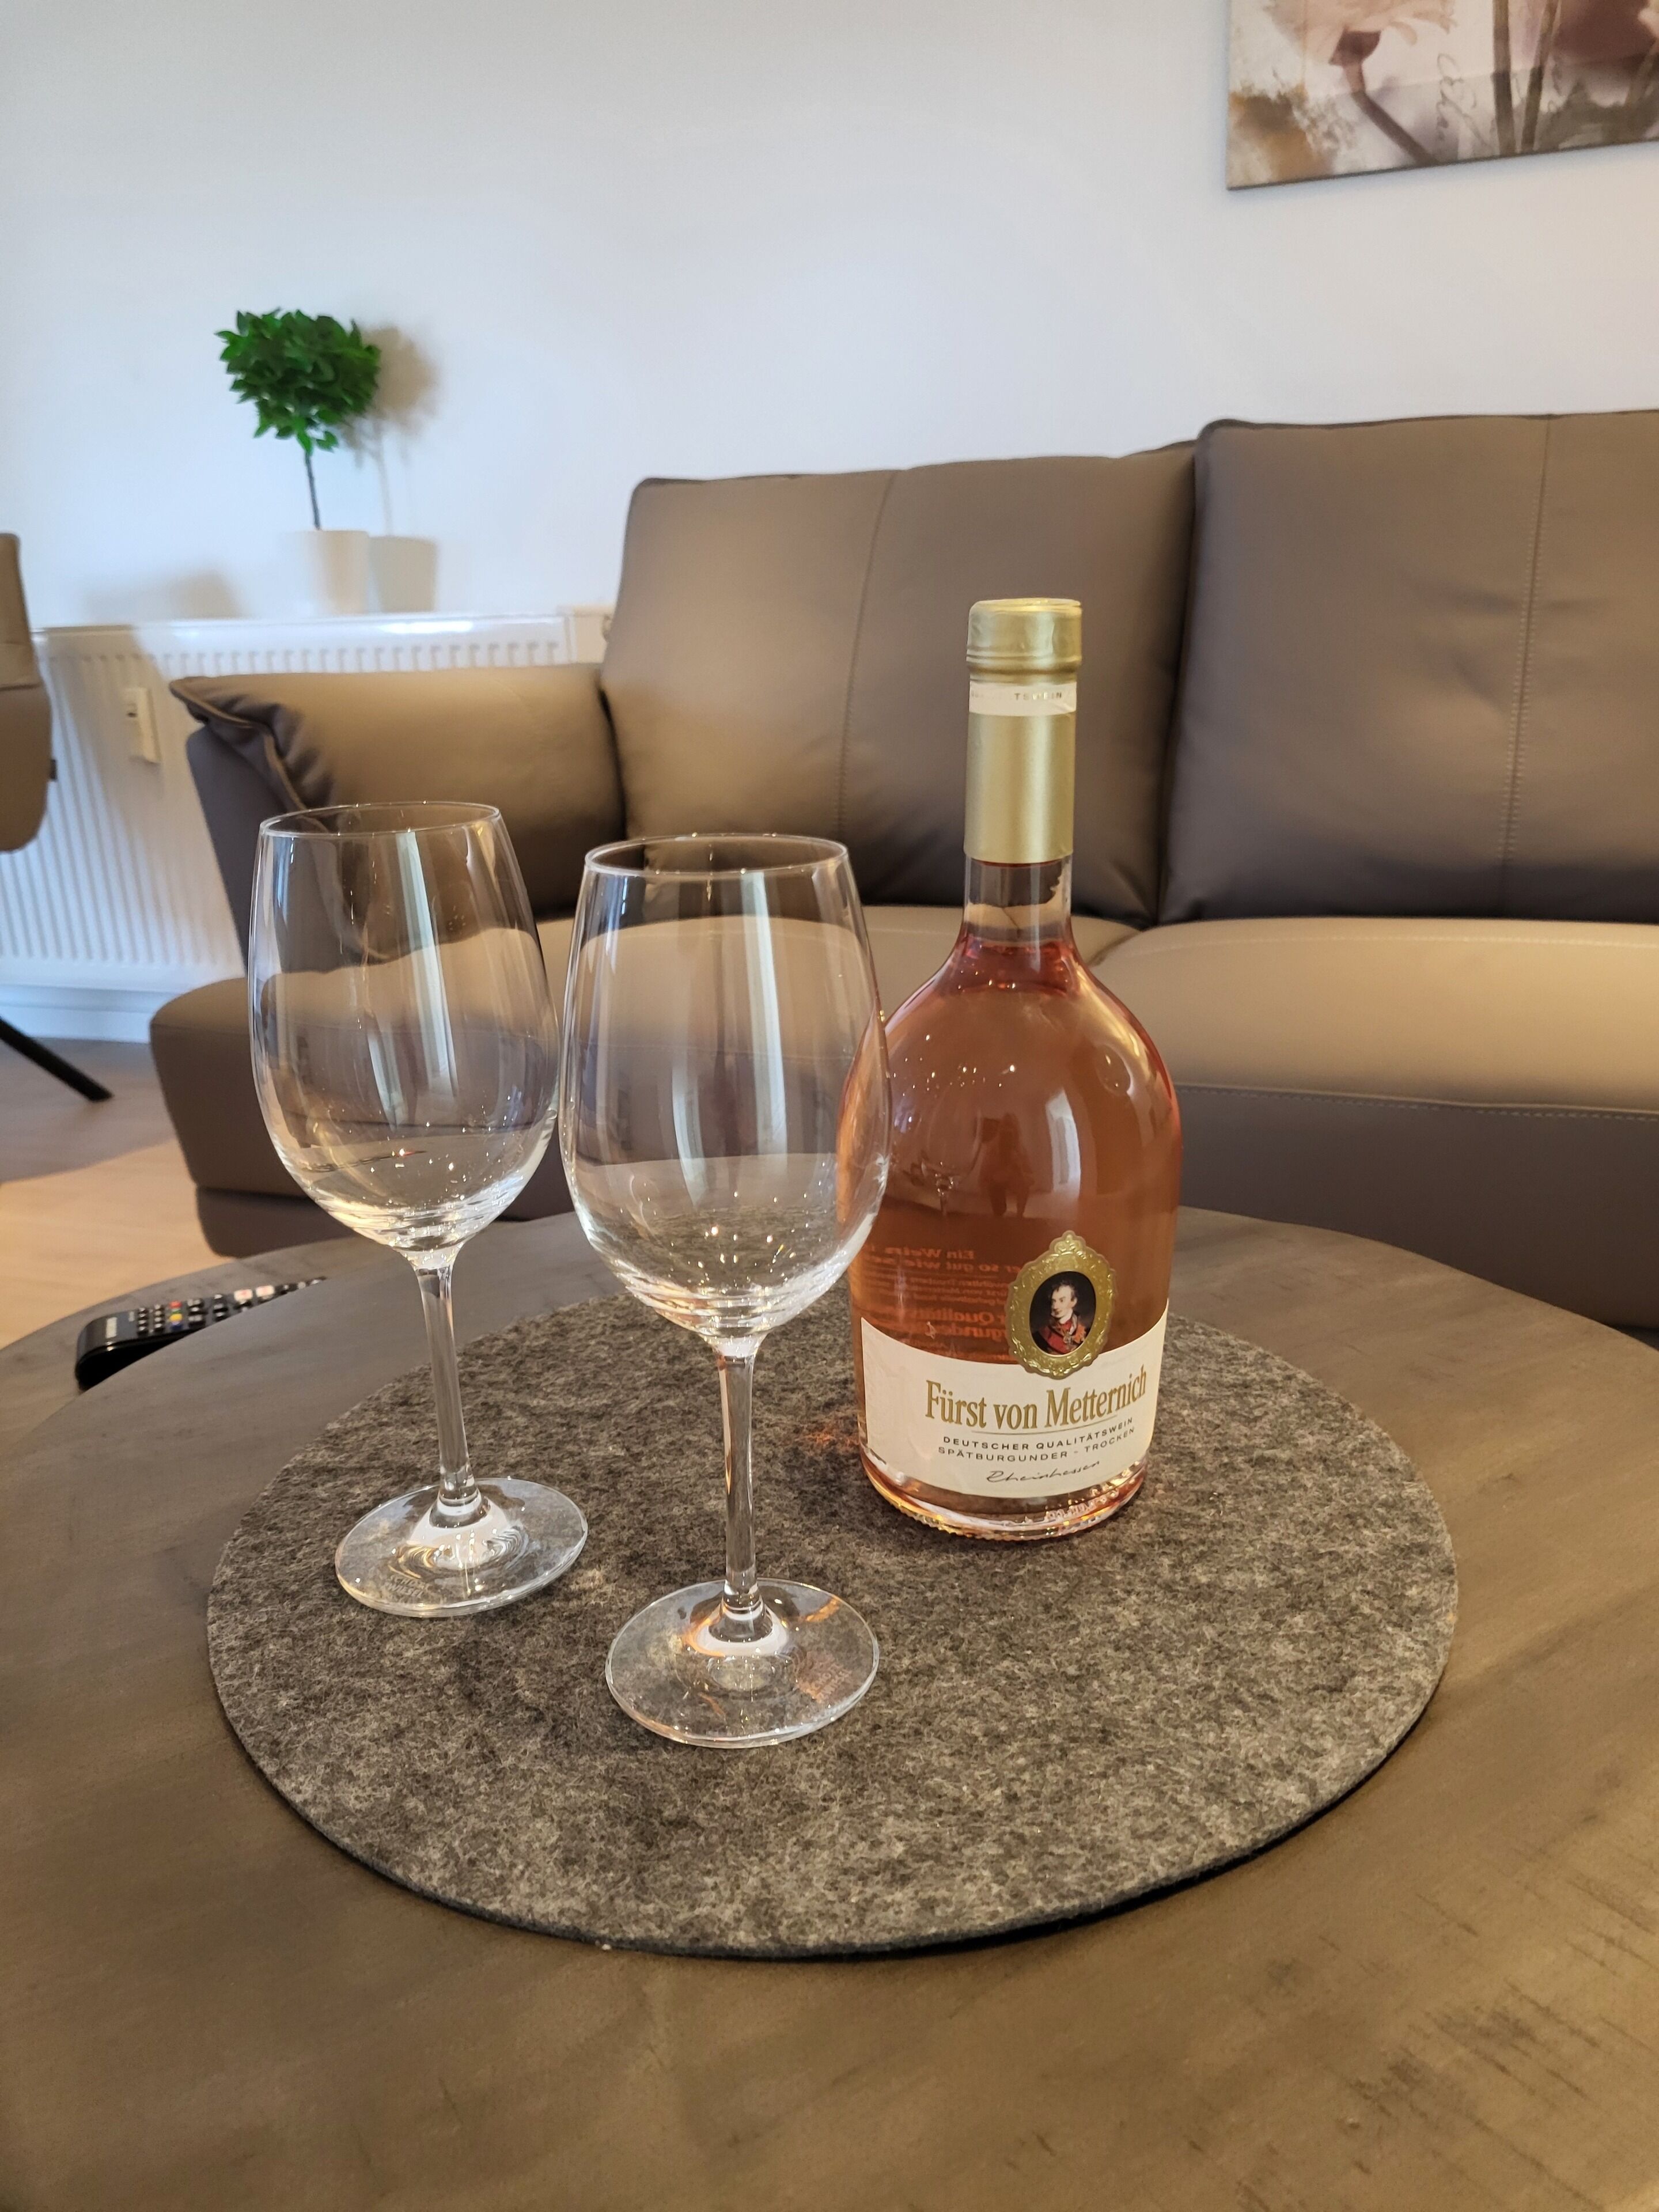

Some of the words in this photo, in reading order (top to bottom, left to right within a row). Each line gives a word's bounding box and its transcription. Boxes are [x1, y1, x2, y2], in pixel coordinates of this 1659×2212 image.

[925, 1380, 987, 1429] Fürst
[993, 1403, 1038, 1430] von
[1044, 1363, 1147, 1429] Metternich
[938, 1446, 1068, 1462] SPÄTBURGUNDER
[1084, 1426, 1135, 1453] TROCKEN
[943, 1436, 1029, 1450] DEUTSCHER
[1036, 1417, 1133, 1450] QUALITÄTSWEIN
[986, 1460, 1100, 1483] Rheinhessen
